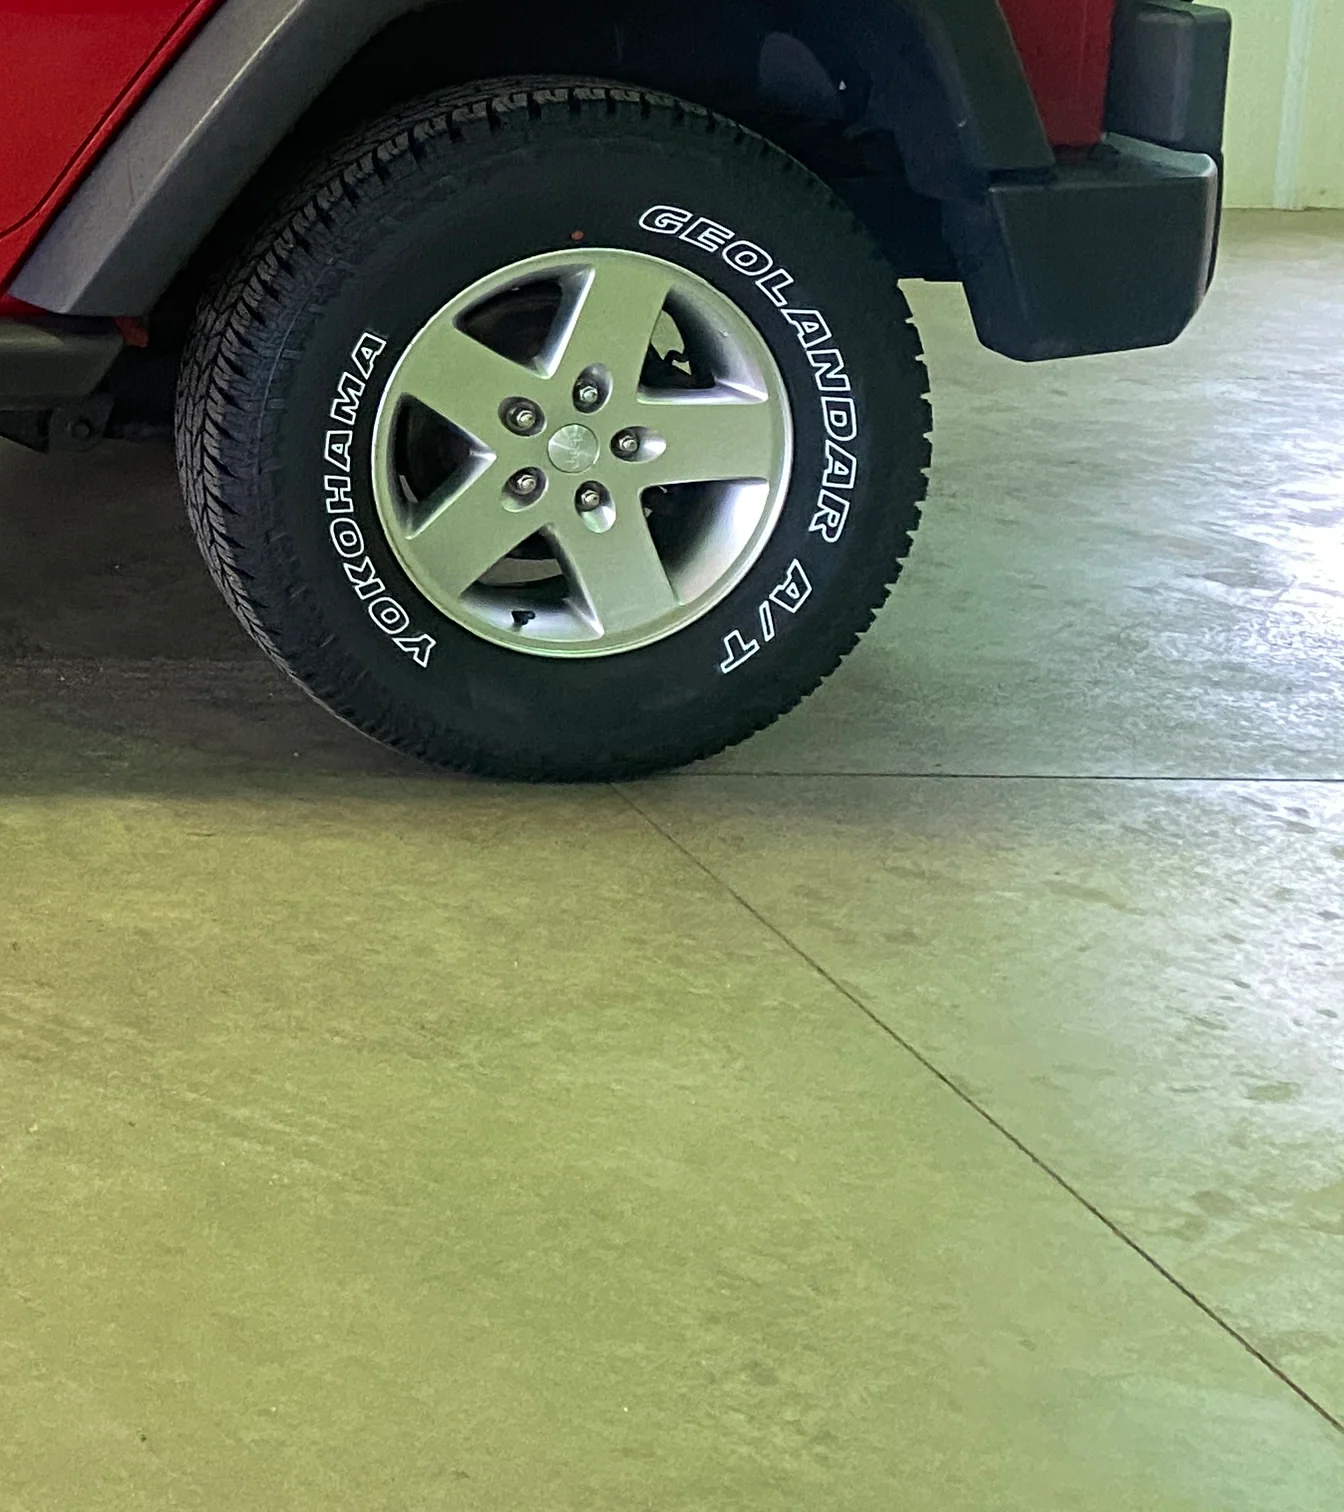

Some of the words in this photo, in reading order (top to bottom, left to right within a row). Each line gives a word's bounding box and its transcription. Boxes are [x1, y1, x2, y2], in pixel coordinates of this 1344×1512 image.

[324, 333, 436, 667] YOKOHAMA
[639, 206, 857, 542] GEOLANDAR
[721, 559, 812, 673] A/T
